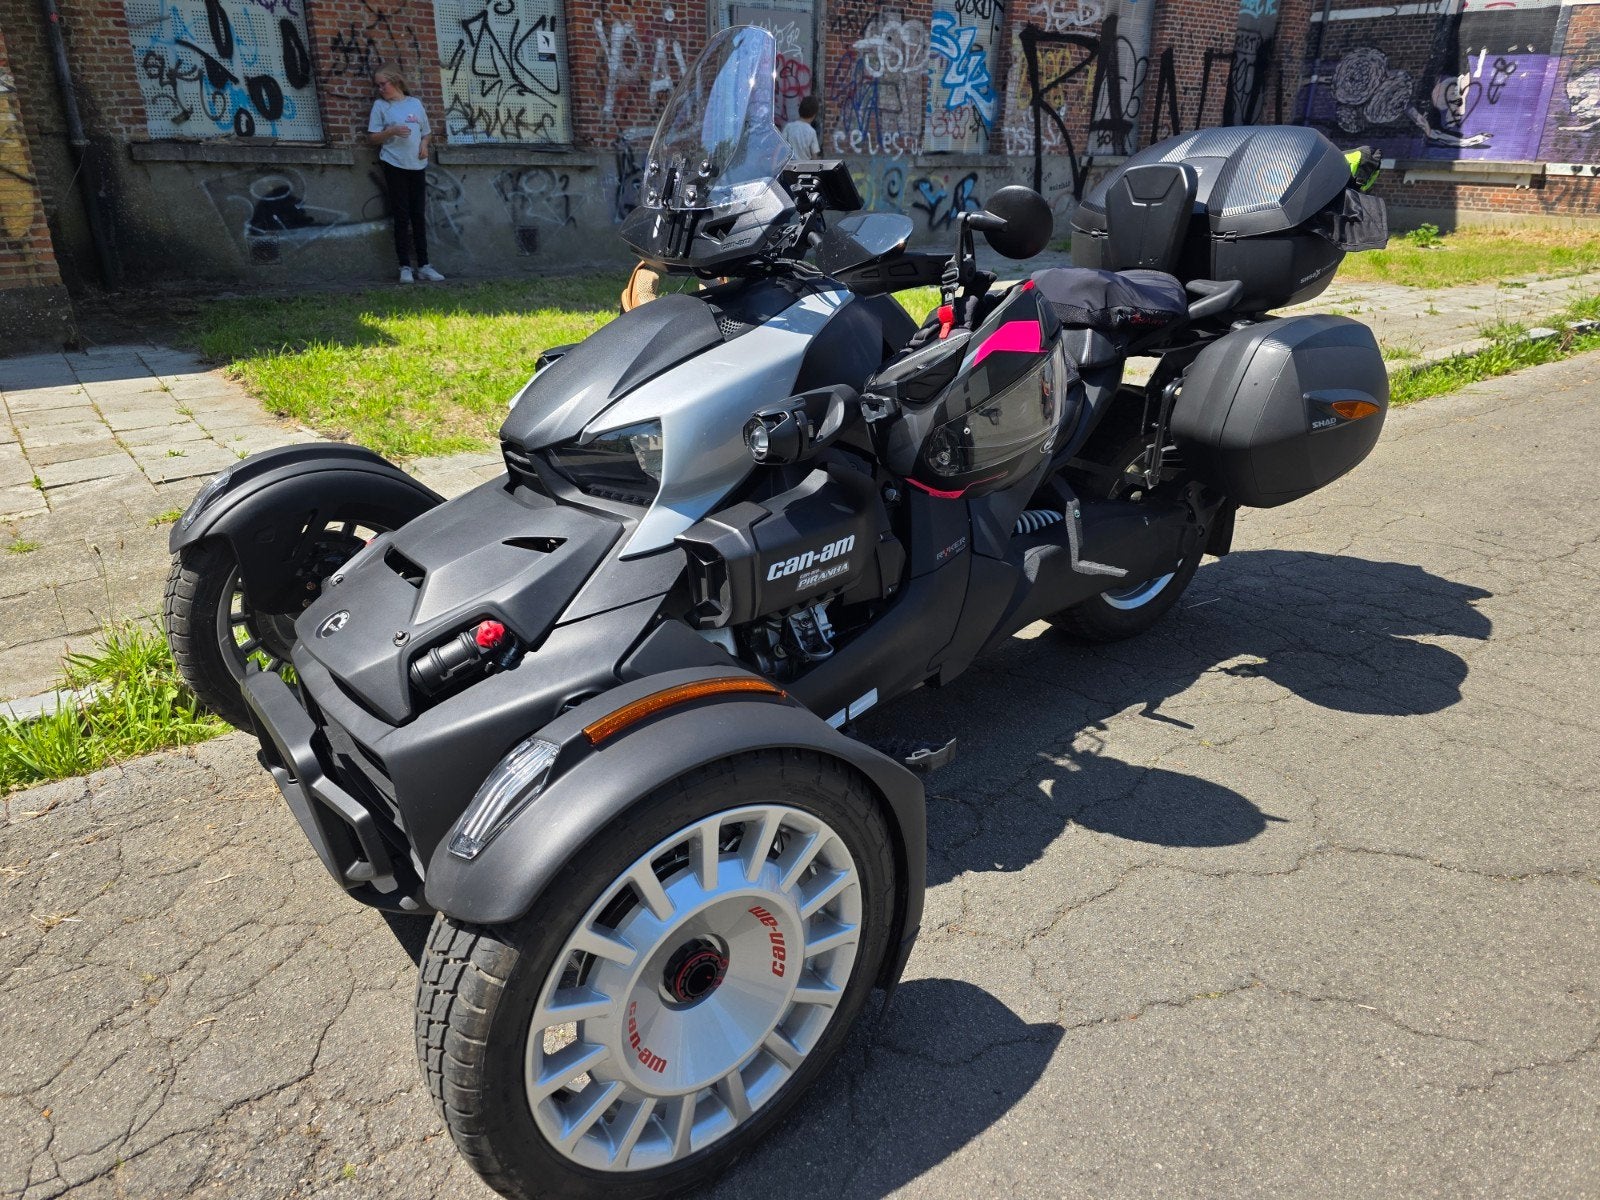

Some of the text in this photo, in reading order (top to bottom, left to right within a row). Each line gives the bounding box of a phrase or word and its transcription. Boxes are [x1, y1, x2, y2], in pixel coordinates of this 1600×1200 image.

[1312, 417, 1337, 429] SHAD
[766, 534, 856, 582] can-am
[798, 561, 849, 588] PIRANHA
[748, 905, 786, 978] can-am
[628, 1001, 667, 1073] can-am
